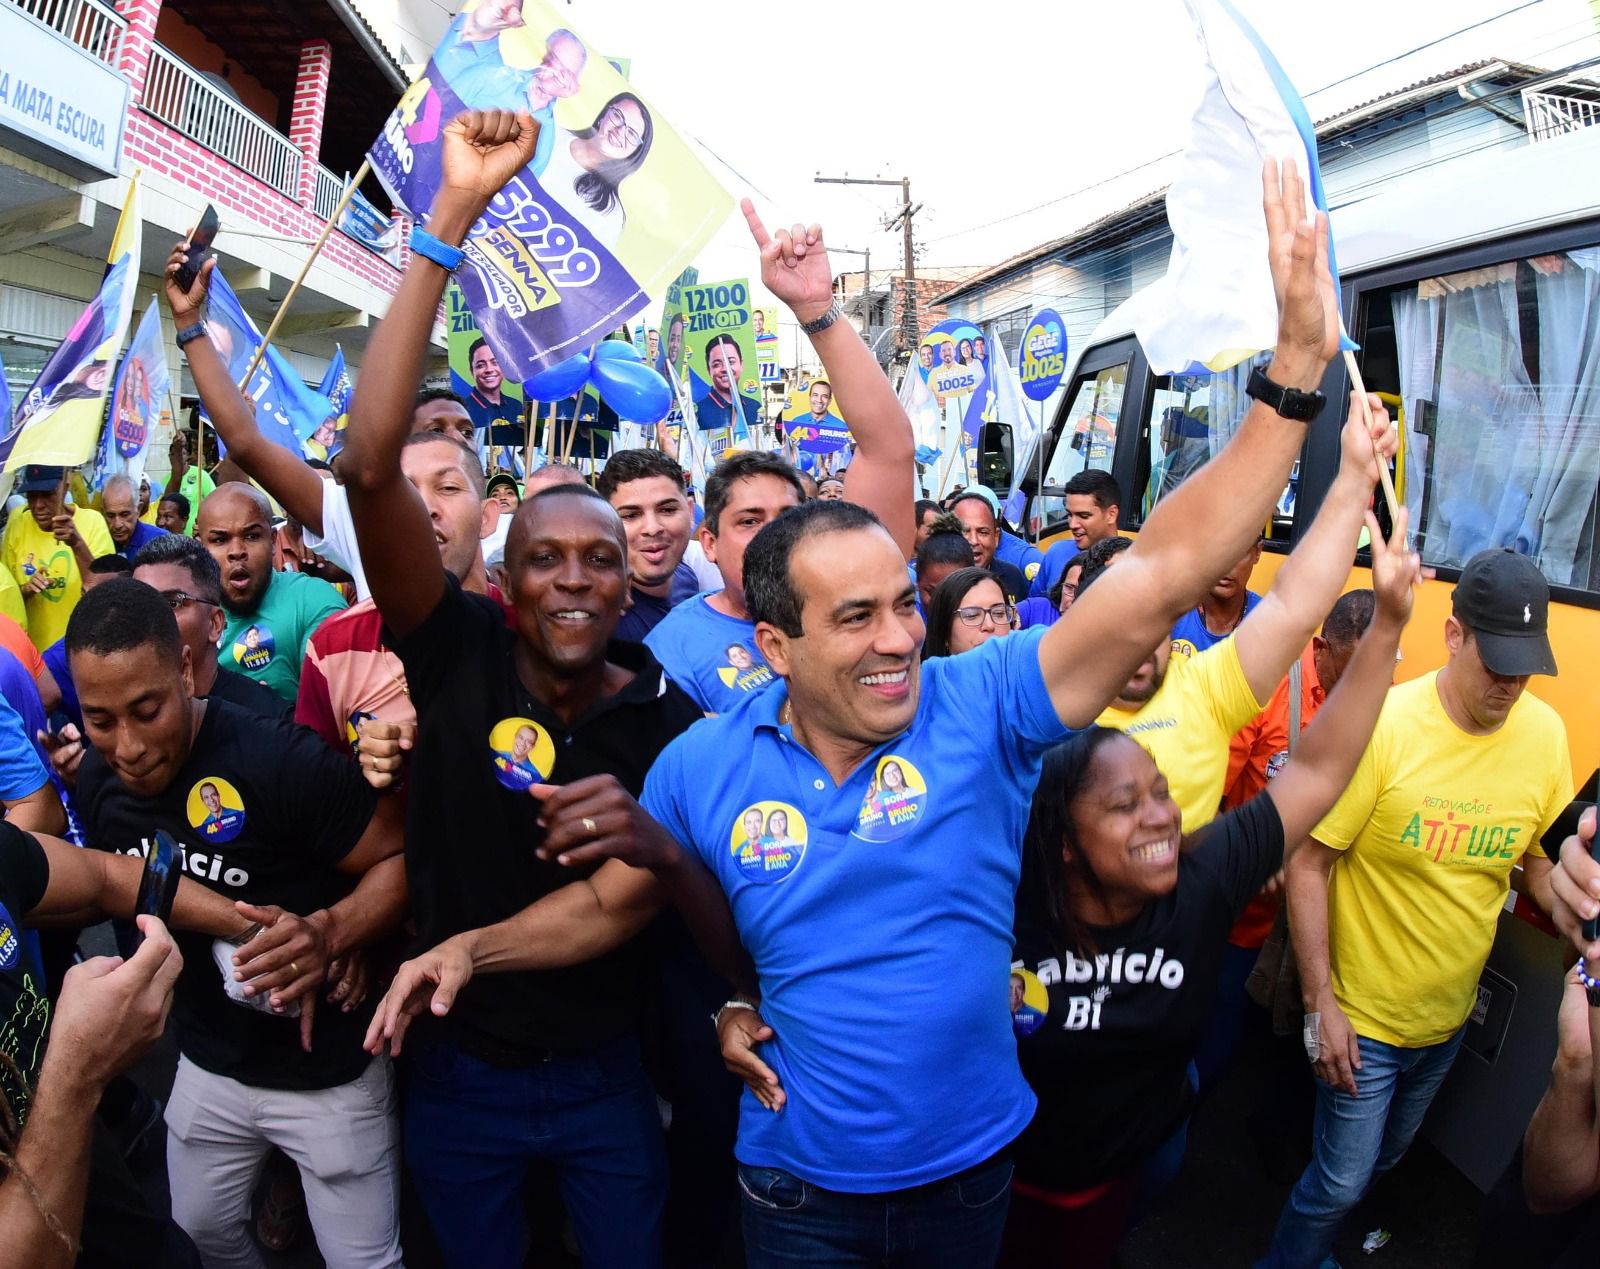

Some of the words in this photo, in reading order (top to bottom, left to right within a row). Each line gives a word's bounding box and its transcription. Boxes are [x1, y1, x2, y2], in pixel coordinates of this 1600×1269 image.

[12, 80, 53, 126] MATA
[56, 101, 104, 151] ESCURA
[485, 231, 547, 305] SENNA
[475, 254, 523, 315] SALVADOR
[685, 283, 746, 313] 12100
[936, 374, 975, 392] 10025
[1020, 354, 1064, 384] 10025
[791, 426, 808, 440] 44
[819, 428, 848, 438] BRUNO
